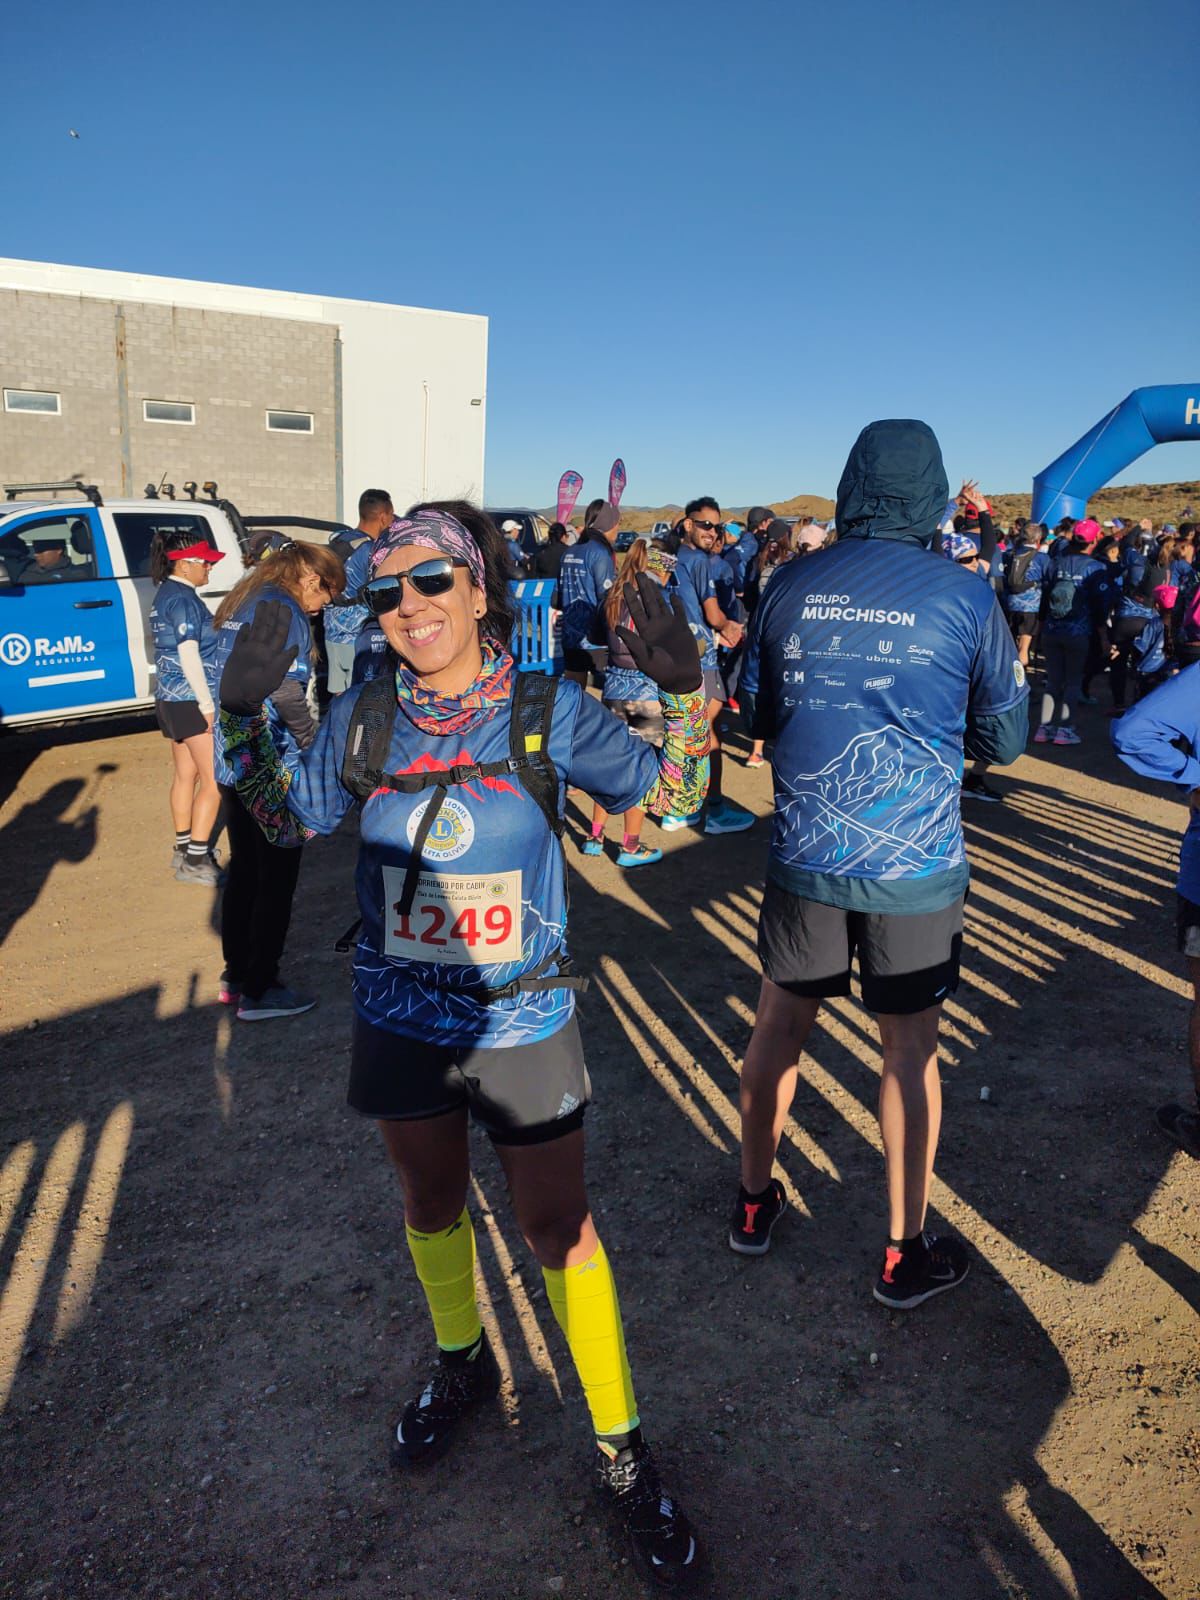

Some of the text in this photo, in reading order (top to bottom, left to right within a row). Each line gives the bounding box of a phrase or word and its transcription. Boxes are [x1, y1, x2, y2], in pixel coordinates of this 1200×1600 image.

[805, 594, 850, 605] GRUPO
[801, 606, 916, 627] MURCHISON
[34, 655, 96, 666] SEGURIDAD
[866, 655, 902, 664] ubnet
[424, 847, 441, 858] LETA
[443, 843, 466, 858] OLIVIA
[417, 878, 449, 889] ORRIENDO
[450, 882, 464, 890] POR
[393, 901, 512, 947] 1249
